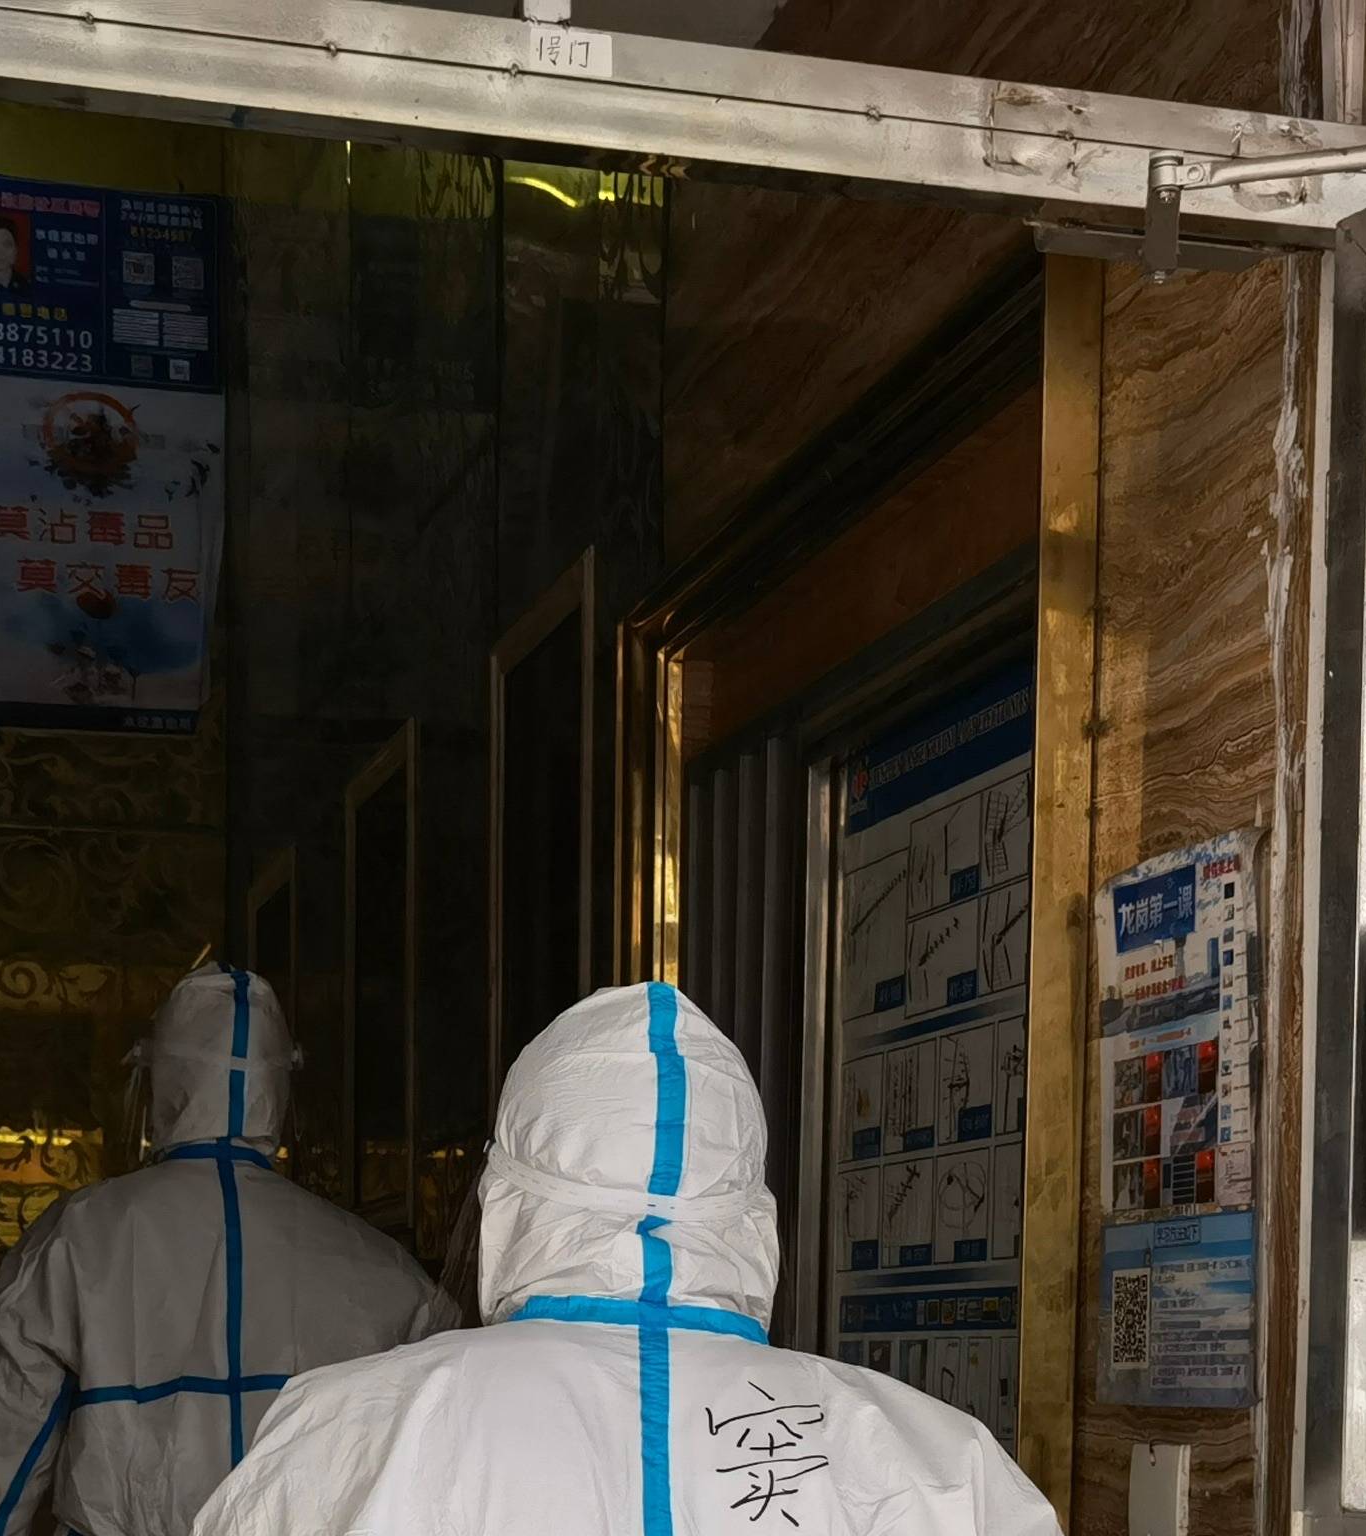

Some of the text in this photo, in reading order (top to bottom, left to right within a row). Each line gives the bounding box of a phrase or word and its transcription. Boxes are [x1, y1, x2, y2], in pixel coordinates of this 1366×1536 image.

[16, 558, 201, 606] 莫交毒友
[1117, 884, 1194, 938] 龙岗第一课
